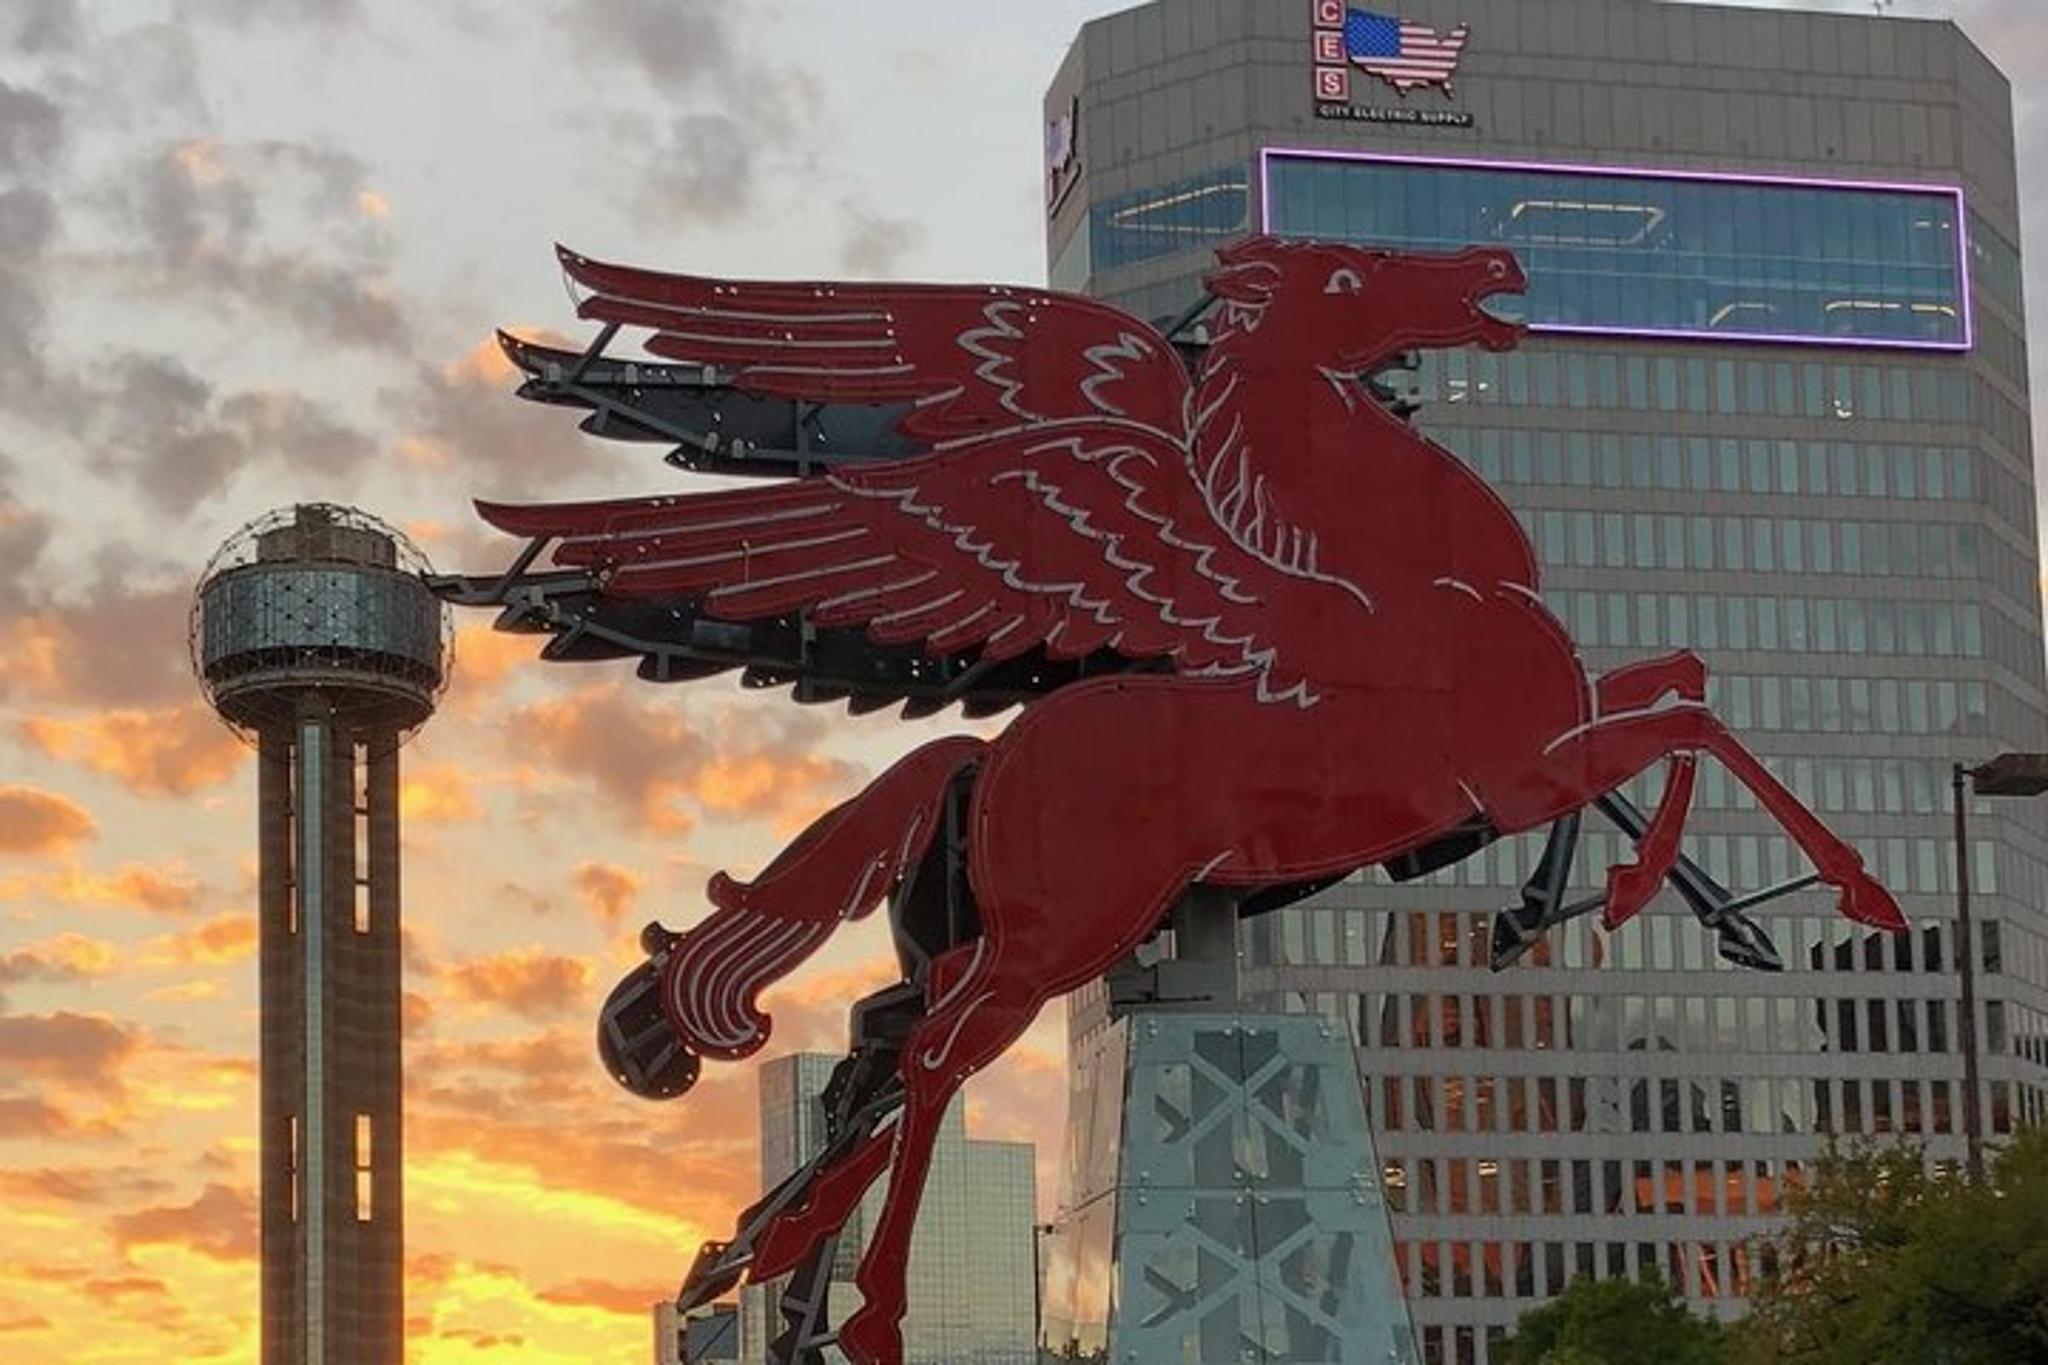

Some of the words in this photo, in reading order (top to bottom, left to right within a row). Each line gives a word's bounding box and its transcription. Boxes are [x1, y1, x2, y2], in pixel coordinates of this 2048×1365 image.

[1319, 1, 1343, 95] CES
[1319, 104, 1350, 117] CITY
[1353, 107, 1417, 121] ELECTRIC
[1421, 111, 1468, 124] SUPPLY
